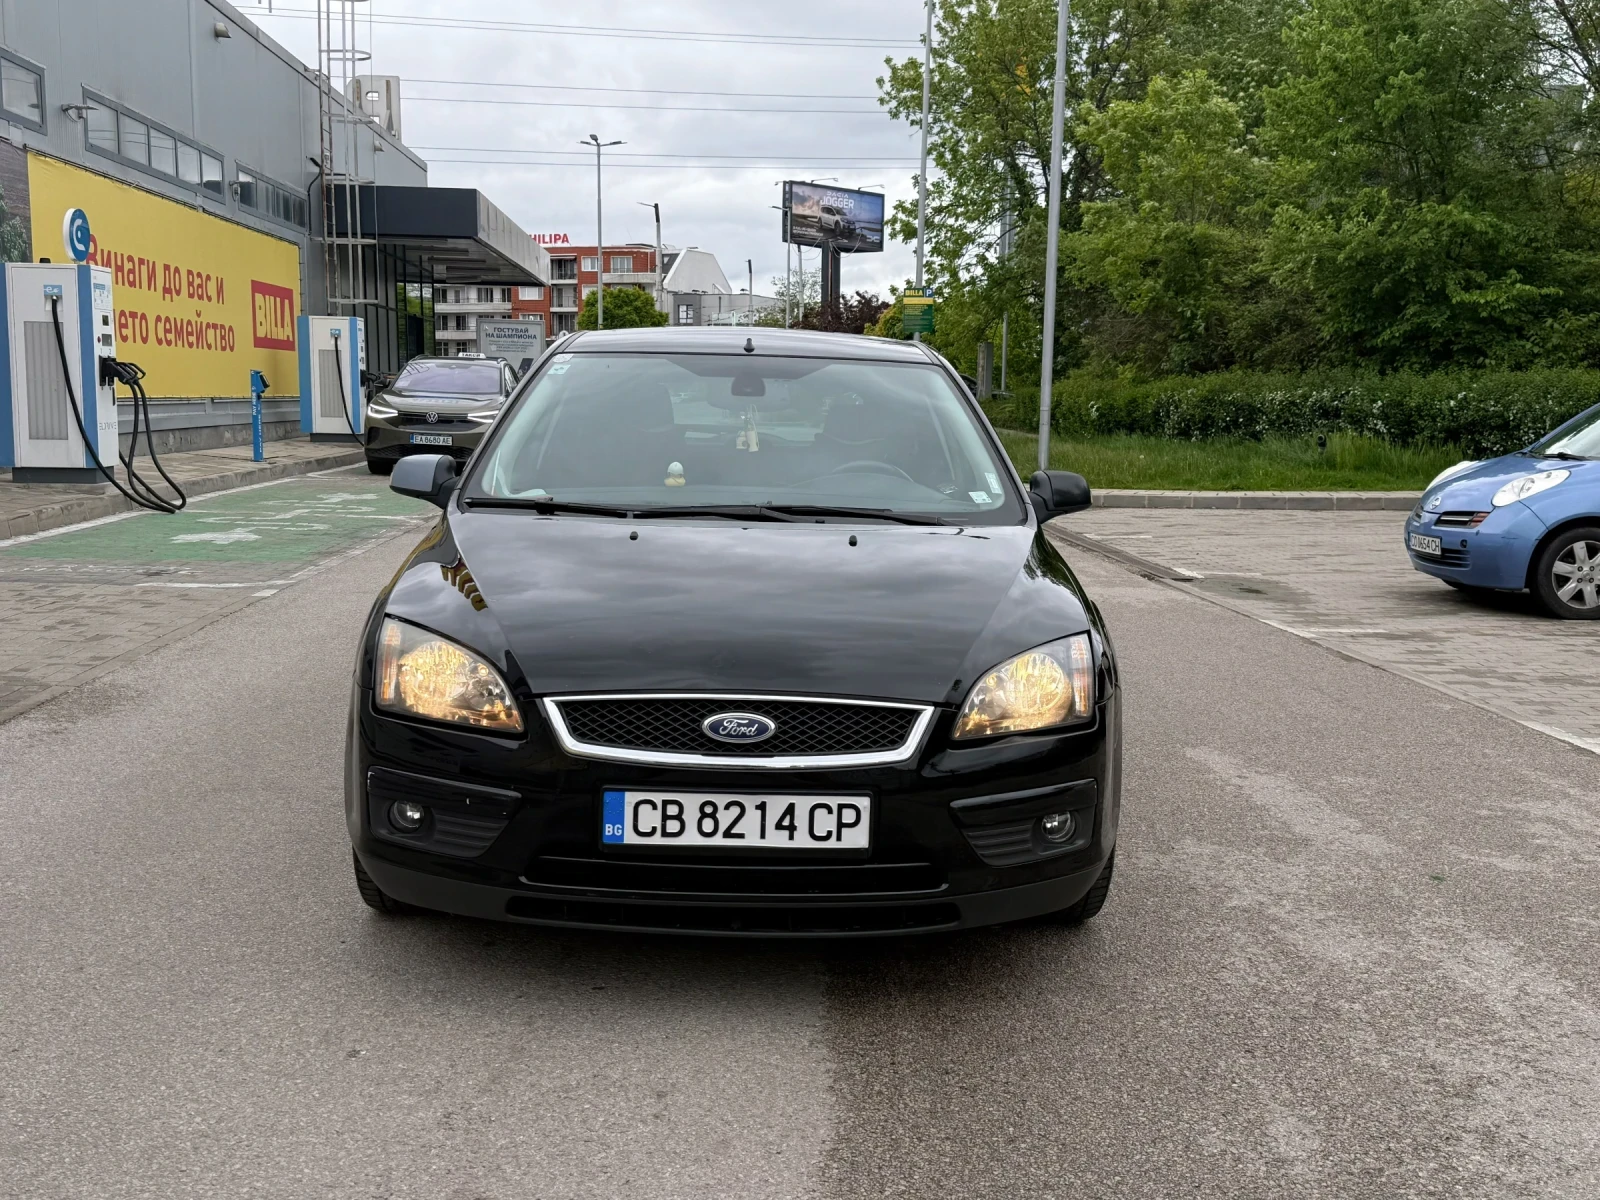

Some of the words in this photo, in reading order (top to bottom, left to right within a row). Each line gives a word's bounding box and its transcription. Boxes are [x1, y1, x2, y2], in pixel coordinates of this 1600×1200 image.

[820, 196, 855, 209] JOGGER
[163, 263, 182, 302] до
[187, 269, 212, 302] вас
[216, 276, 225, 305] и
[255, 292, 293, 342] BILLA
[155, 310, 235, 352] семейство
[493, 326, 529, 334] ГОСТУВАЙ
[425, 436, 441, 444] 8680
[1431, 539, 1440, 553] CH
[719, 717, 758, 737] Ford
[632, 798, 686, 838] CB
[697, 799, 798, 841] 8214
[808, 802, 862, 842] CP
[605, 823, 623, 837] BG
